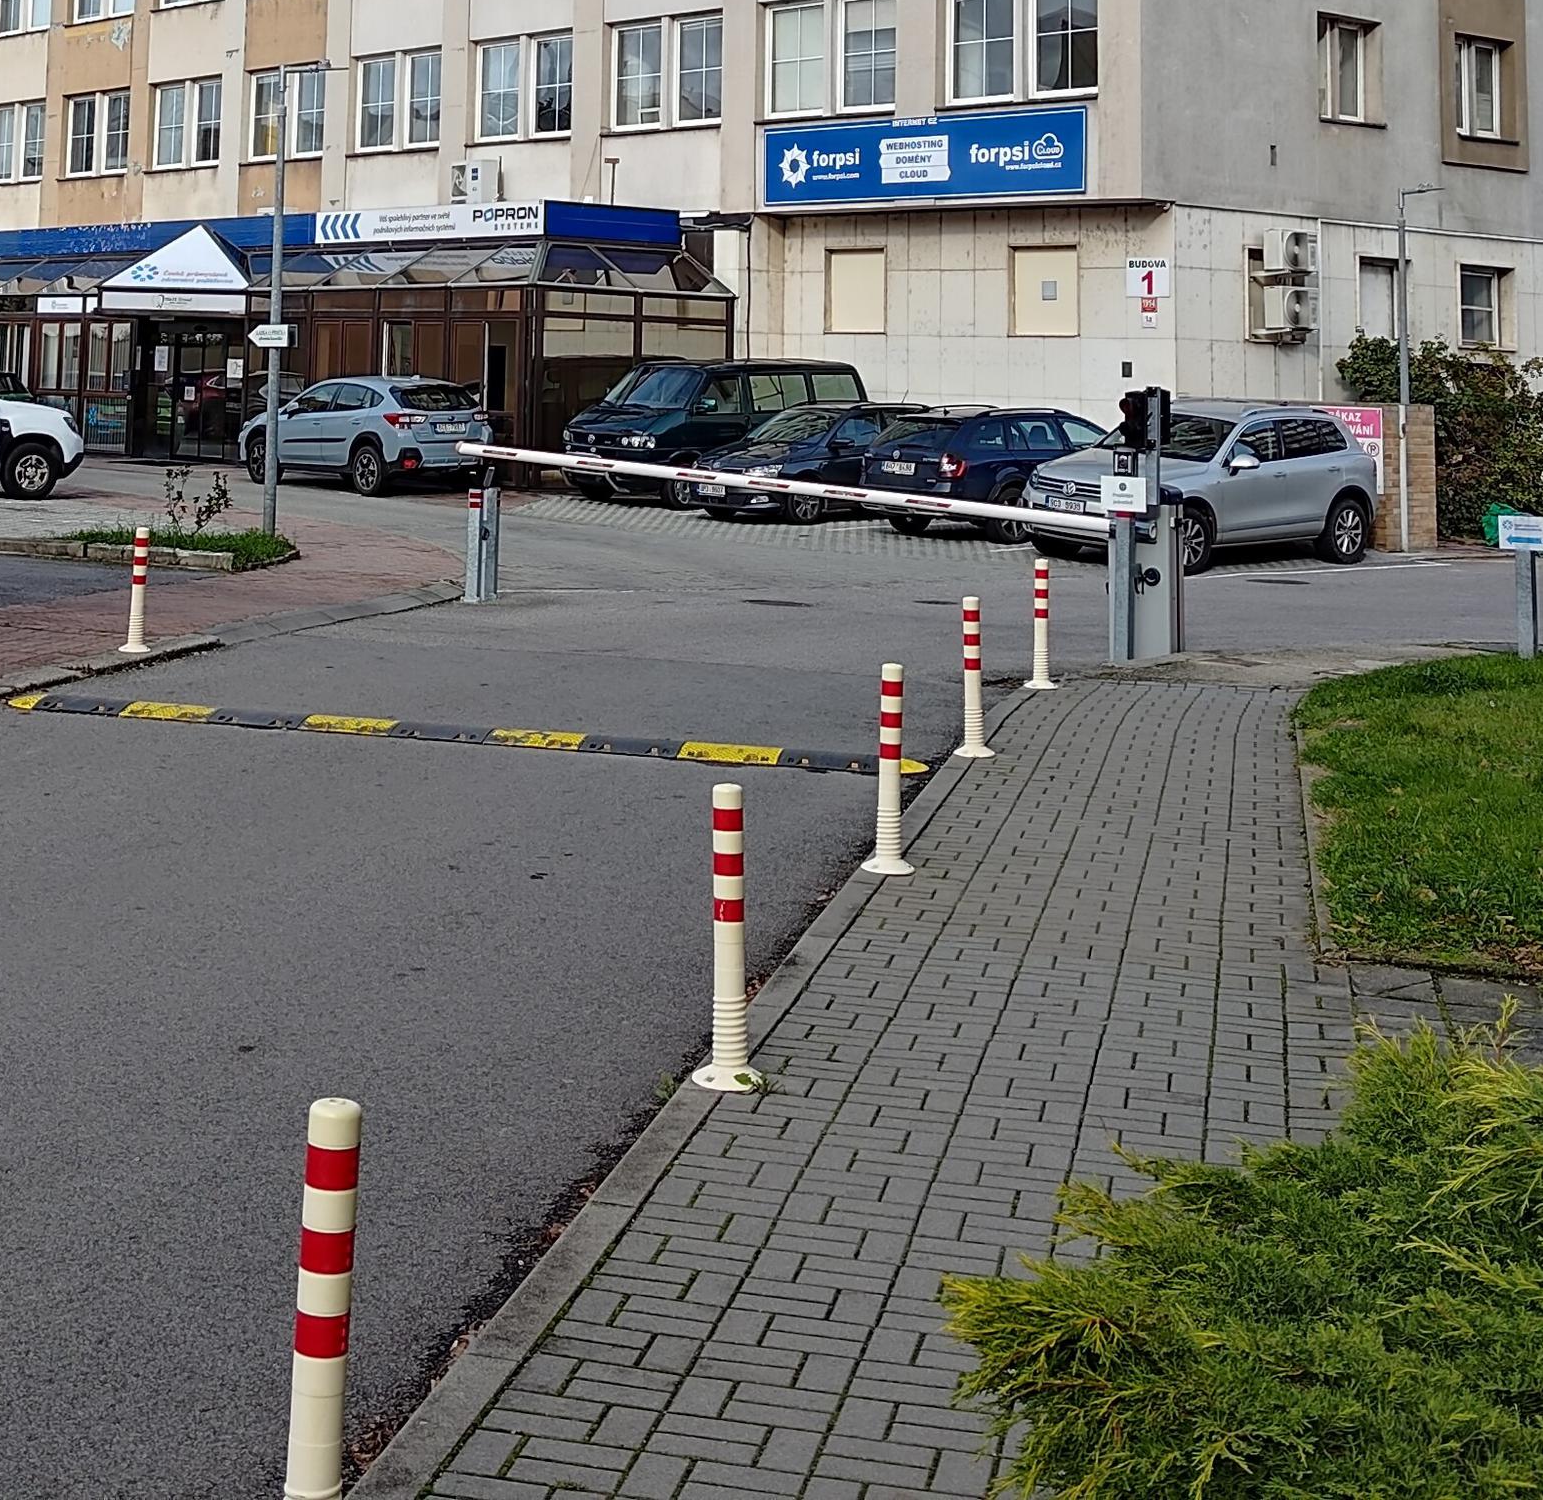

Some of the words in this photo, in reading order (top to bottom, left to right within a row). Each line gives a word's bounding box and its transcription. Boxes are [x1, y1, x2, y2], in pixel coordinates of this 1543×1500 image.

[886, 139, 943, 151] WEBHOSTING
[812, 147, 860, 170] forpsi
[895, 154, 932, 165] DOMÉNY
[969, 140, 1029, 167] forpsi
[899, 169, 928, 179] CLOUD
[473, 206, 538, 222] POPRON
[1128, 260, 1166, 268] BUDOVA
[1141, 270, 1153, 295] 1
